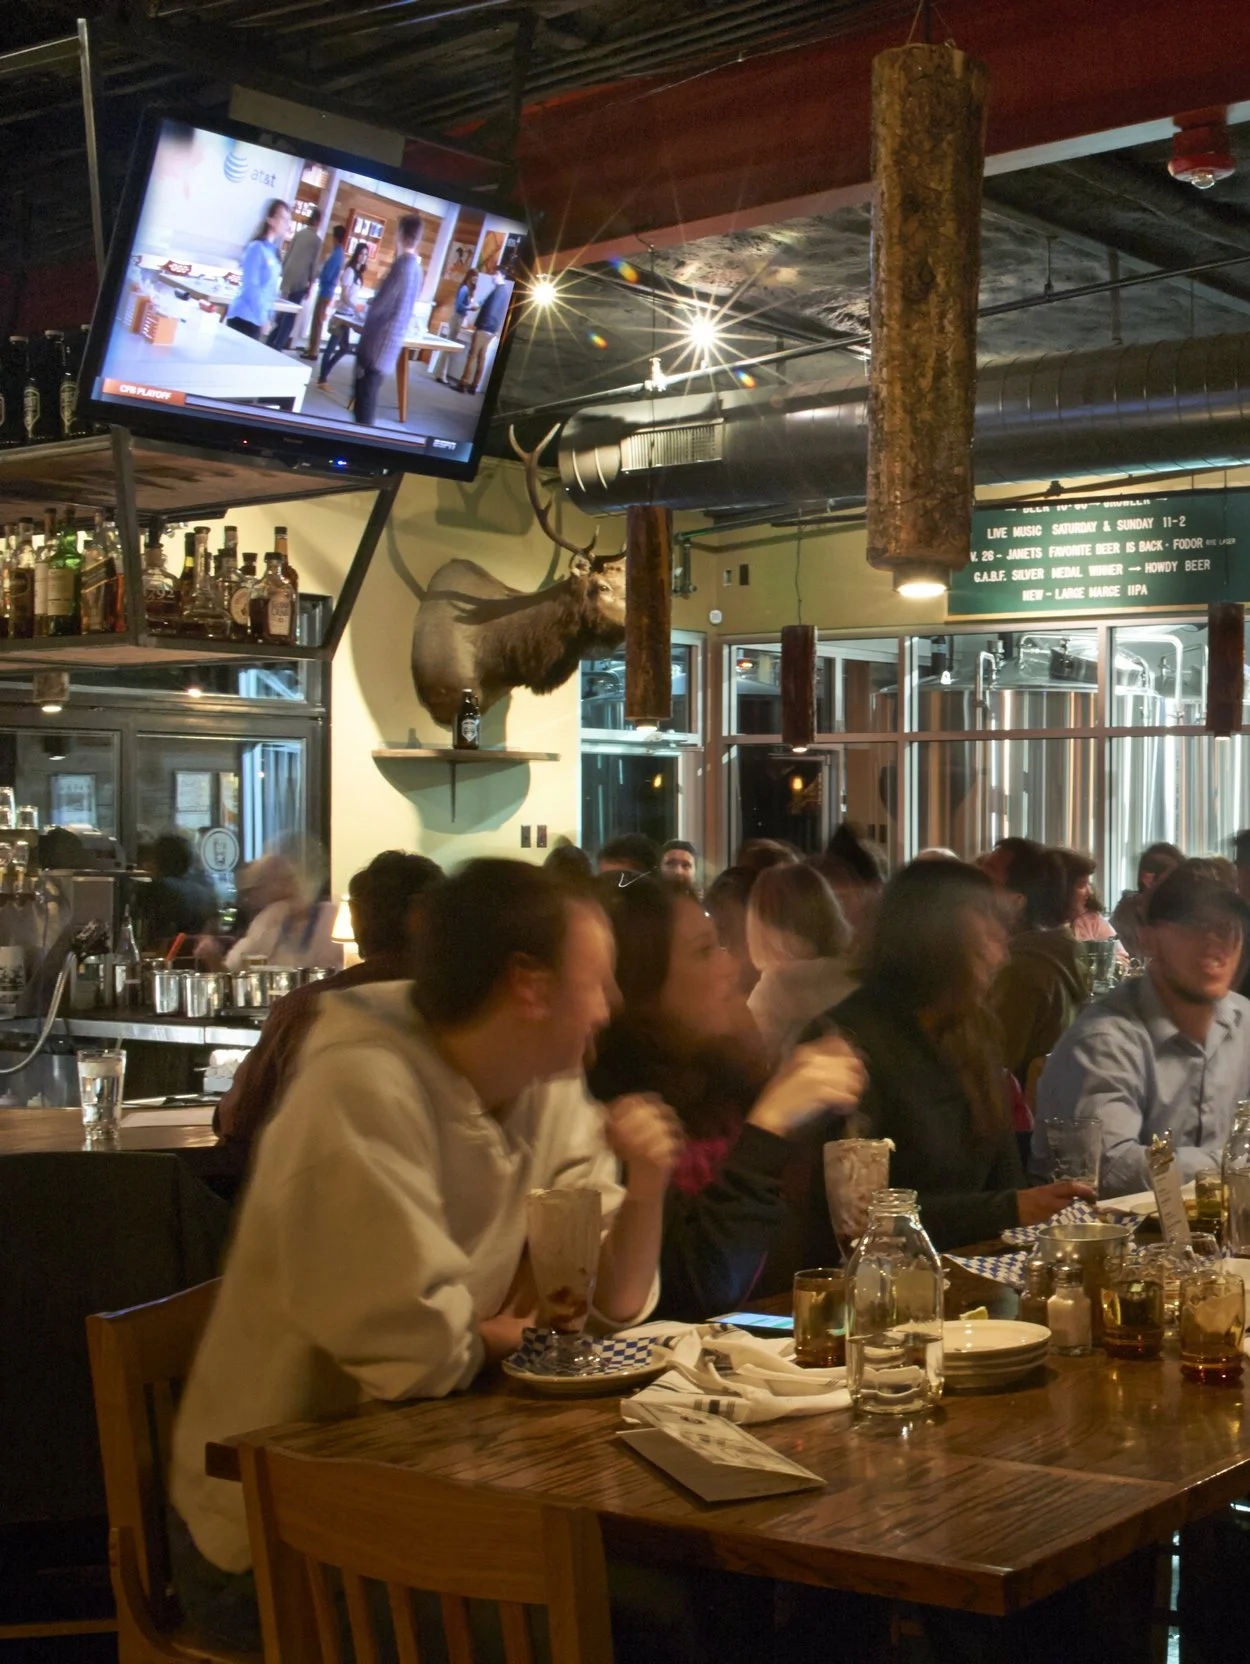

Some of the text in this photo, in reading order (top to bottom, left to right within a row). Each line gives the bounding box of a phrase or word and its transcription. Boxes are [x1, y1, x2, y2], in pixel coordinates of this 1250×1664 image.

[987, 526, 1008, 539] LIVE
[1012, 525, 1043, 538] MUSIC
[1051, 520, 1098, 535] SATURDAY
[1116, 517, 1154, 531] SUNDAY
[1162, 515, 1187, 528] 11-2
[1006, 547, 1043, 560] JANETS
[1049, 543, 1093, 558] FAVORITE
[1095, 542, 1121, 555] BEER
[1126, 541, 1136, 553] IS
[1139, 539, 1164, 553] BACK
[1173, 537, 1204, 550] FODOR
[1011, 568, 1045, 581] SILVER
[1051, 566, 1083, 579] MEDAL
[1088, 563, 1124, 576] WINNER
[1144, 561, 1179, 574] HOWDY
[1184, 559, 1212, 572] BEER
[1022, 589, 1044, 602] NEW
[1054, 587, 1085, 600] LARGE
[1088, 585, 1121, 598] MARGE
